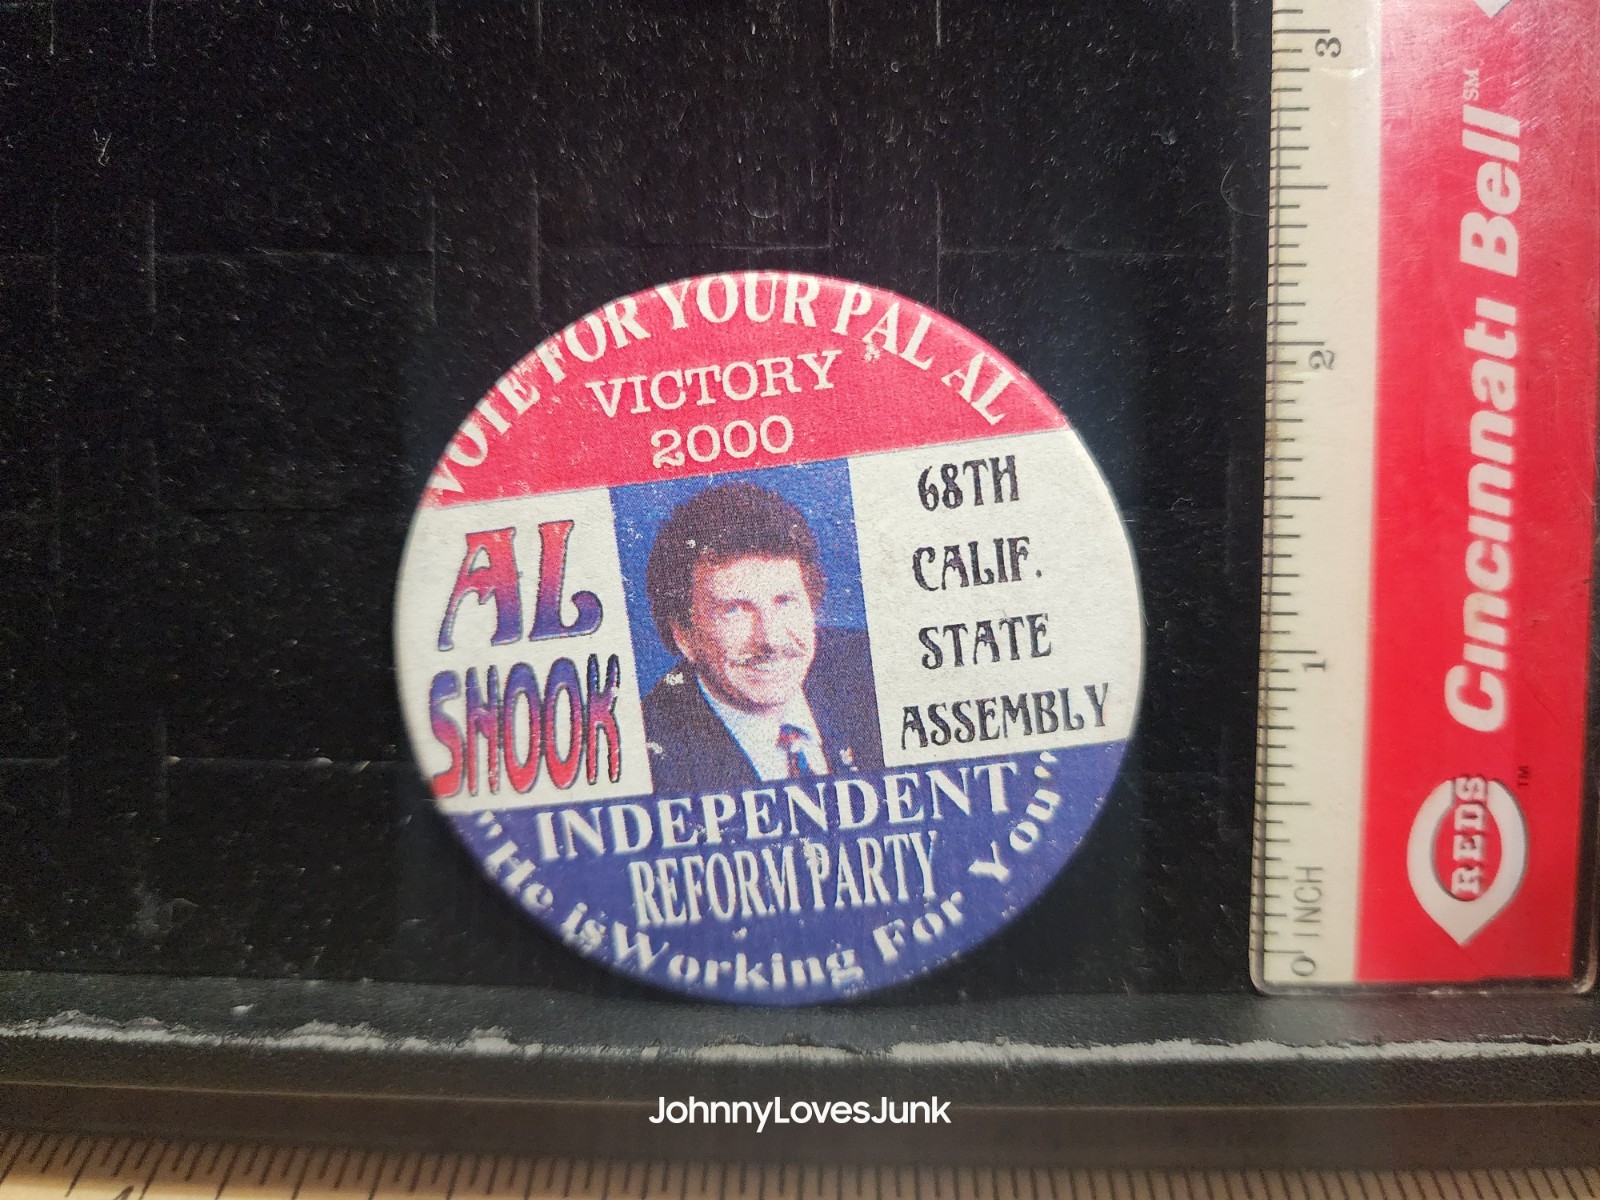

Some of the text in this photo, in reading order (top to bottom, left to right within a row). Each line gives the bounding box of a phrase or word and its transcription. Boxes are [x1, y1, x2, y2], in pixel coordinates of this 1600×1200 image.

[1315, 36, 1343, 60] 3
[1459, 104, 1522, 278] Bell
[534, 295, 652, 384] FOR
[656, 273, 821, 331] YOUR
[831, 283, 934, 371] PAL
[941, 351, 1017, 427] AL
[586, 349, 843, 419] VICTORY
[1308, 349, 1336, 371] 2
[650, 415, 795, 470] 2000
[916, 454, 1021, 512] 68TH
[1443, 297, 1518, 733] Cincinnati
[437, 519, 604, 652] AL
[911, 536, 1043, 592] CALIF.
[917, 613, 1052, 670] STATE
[1302, 660, 1327, 673] 1
[900, 682, 1109, 751] ASSEMBLY
[534, 760, 1020, 862] INDEPENDENT
[1451, 774, 1490, 896] REDS
[626, 830, 938, 930] REFORM PARTY
[1292, 865, 1325, 938] INCH
[612, 922, 866, 991] Working
[872, 891, 966, 966] For
